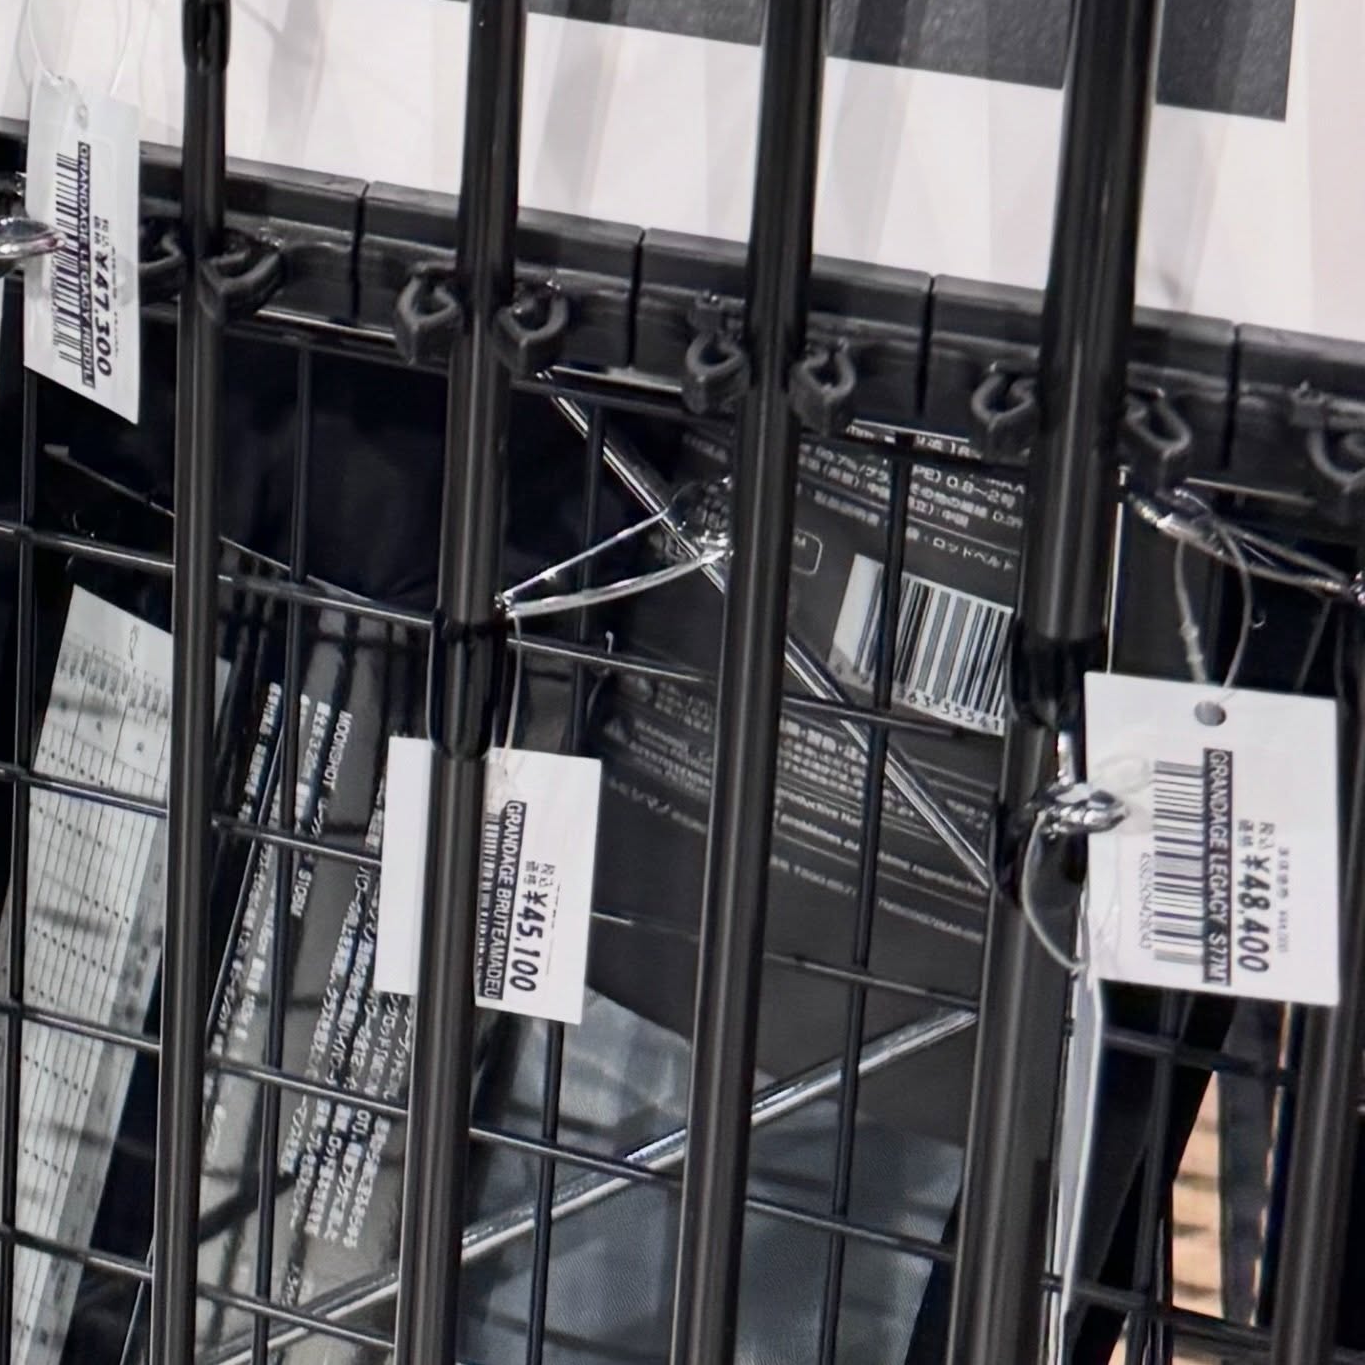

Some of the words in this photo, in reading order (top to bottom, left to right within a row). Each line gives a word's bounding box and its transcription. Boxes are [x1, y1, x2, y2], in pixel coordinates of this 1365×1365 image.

[495, 802, 523, 886] GRANDAGE
[1209, 750, 1230, 848] GRANDAGE
[1209, 853, 1229, 922] LEGACY
[1237, 854, 1271, 974] ¥48,400
[508, 889, 549, 992] ¥45,100
